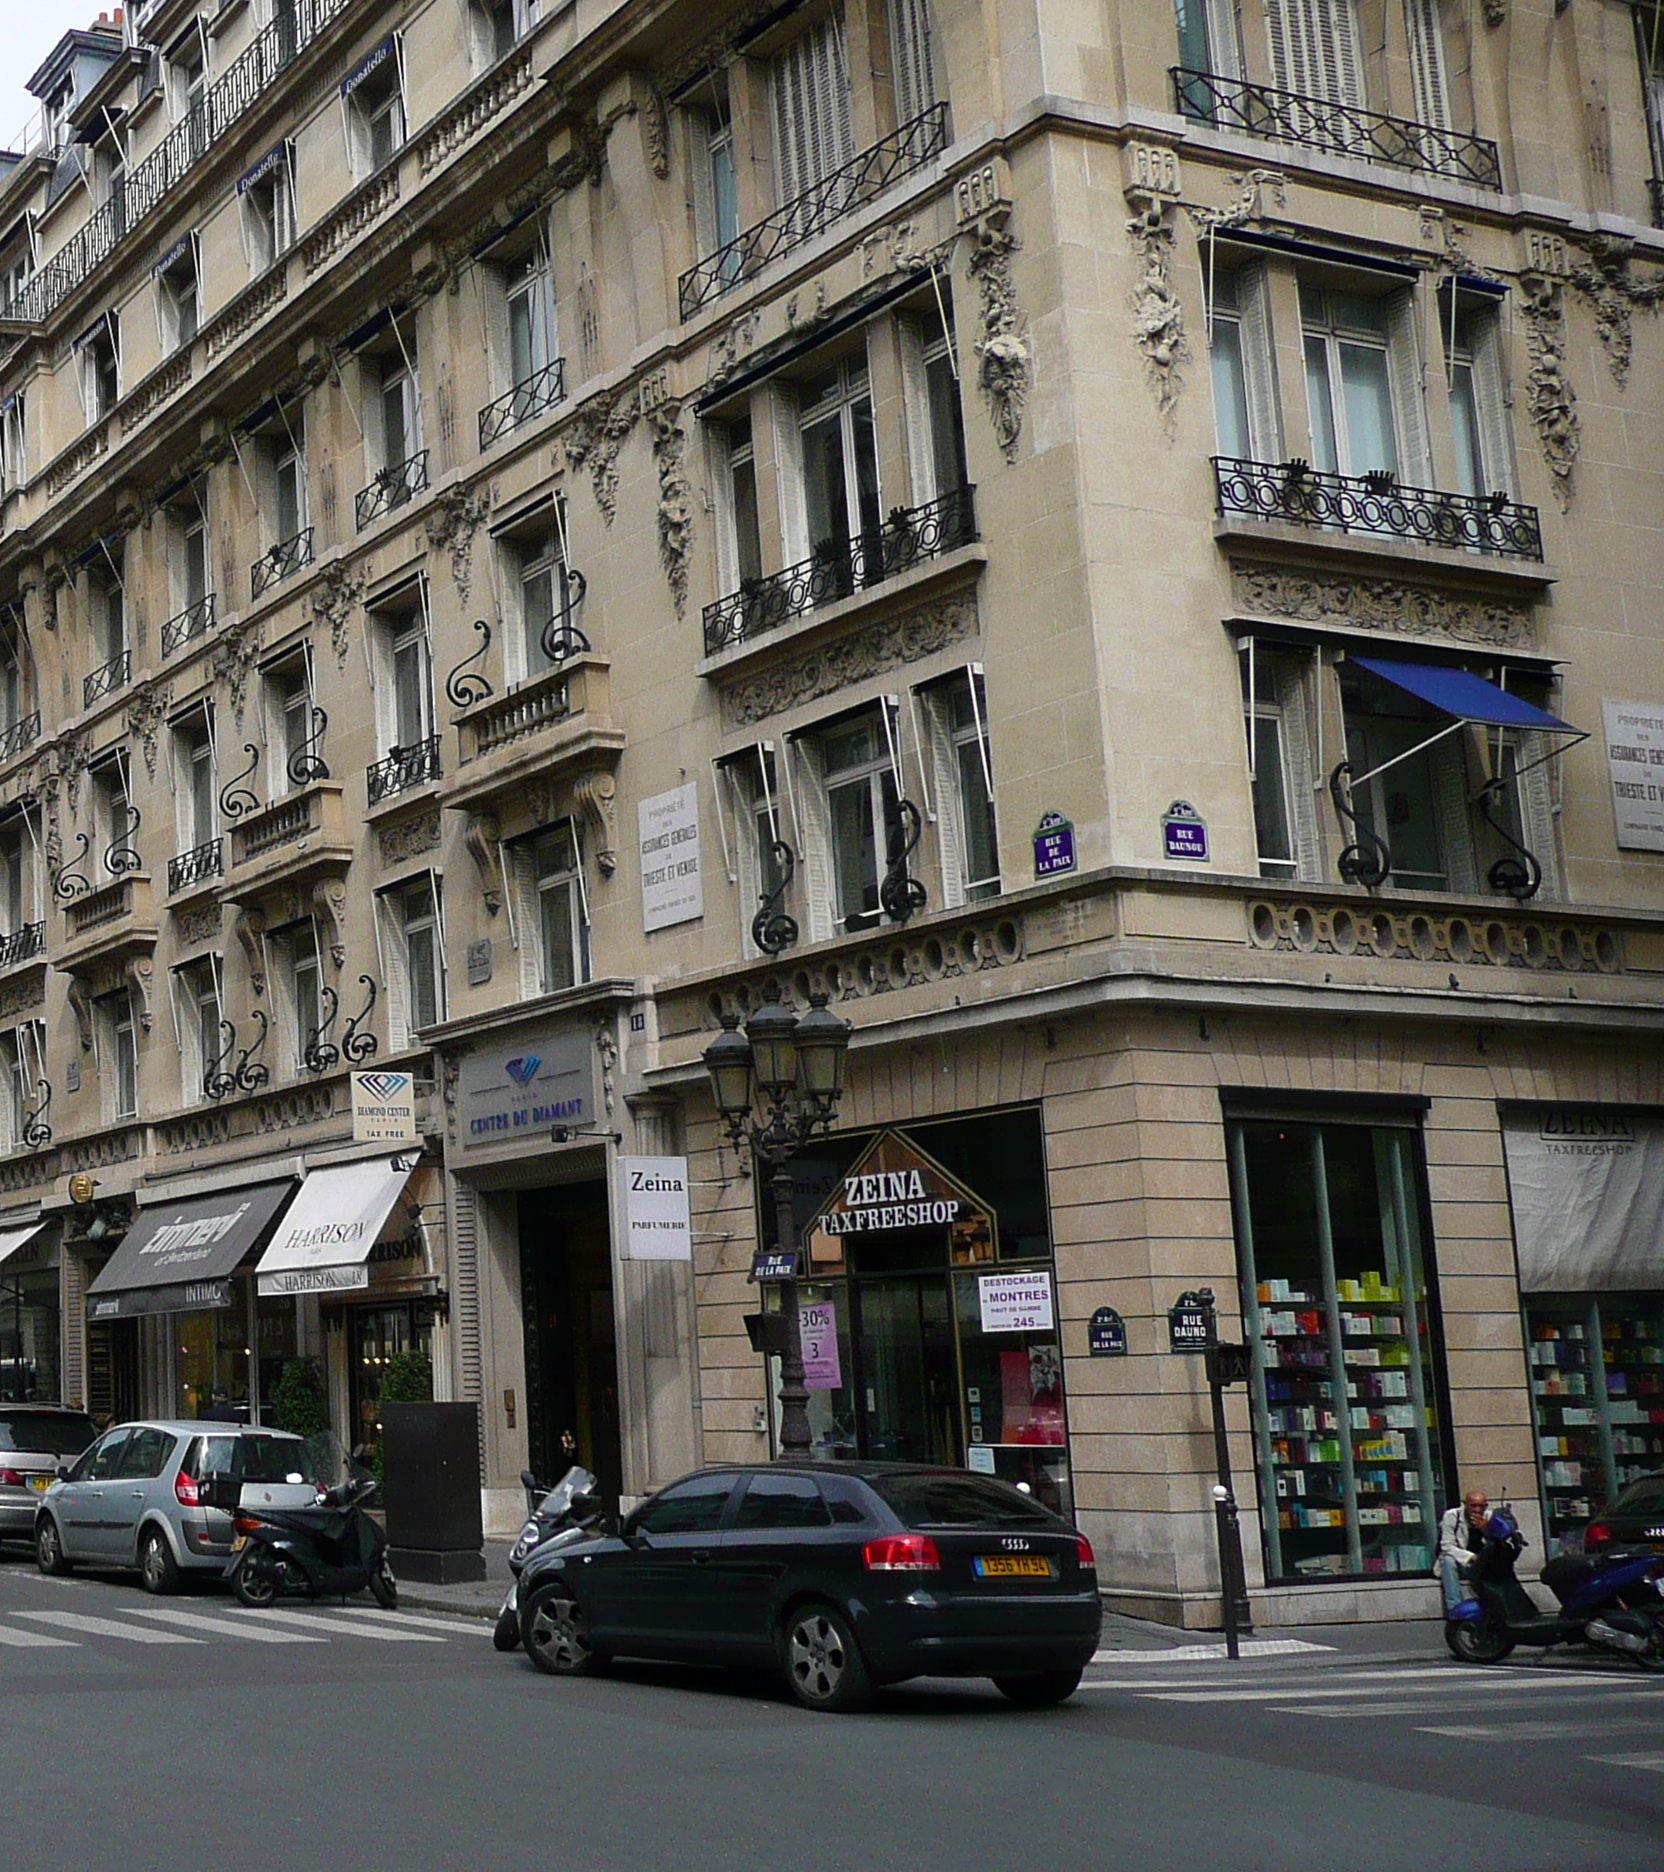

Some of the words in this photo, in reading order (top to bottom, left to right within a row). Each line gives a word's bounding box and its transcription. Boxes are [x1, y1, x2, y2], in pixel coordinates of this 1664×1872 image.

[1614, 781, 1646, 800] TRIESTE
[1648, 785, 1656, 801] ET
[1176, 829, 1194, 840] RUE
[1045, 836, 1062, 847] RUE
[1168, 840, 1204, 852] DAUNOU
[1048, 847, 1059, 857] DE
[1039, 862, 1050, 871] LA
[1053, 855, 1071, 867] PAIX
[643, 867, 666, 888] TRIESTE
[668, 864, 675, 880] ET
[676, 857, 698, 878] VENISE
[631, 1013, 645, 1032] 18
[357, 1106, 386, 1116] DIAMOND
[387, 1107, 411, 1117] CENTER
[470, 1113, 509, 1135] CENTRE
[513, 1108, 529, 1126] DU
[533, 1098, 584, 1122] DIAMANT
[366, 1130, 381, 1138] TAX
[385, 1130, 405, 1138] FREE
[1546, 1144, 1632, 1155] TAXFREESHOP
[631, 1171, 684, 1192] Zeina
[845, 1169, 926, 1206] ZEINA
[818, 1201, 959, 1236] TAXFREESHOP
[631, 1221, 686, 1230] PARFUMERIE
[285, 1220, 372, 1249] HARRISON
[768, 1255, 783, 1265] RUE
[756, 1266, 764, 1276] DE
[765, 1266, 774, 1275] LA
[776, 1265, 791, 1274] PAIX
[285, 1271, 336, 1291] HARRISON
[351, 1270, 362, 1285] 18
[983, 1275, 1045, 1287] DESTOCKAGE
[989, 1289, 1049, 1303] MONTRES
[1013, 1317, 1035, 1328] 245
[1182, 1315, 1203, 1326] RUE
[810, 1342, 819, 1359] 3
[984, 1556, 1014, 1573] 1356
[1031, 1557, 1045, 1573] 94
